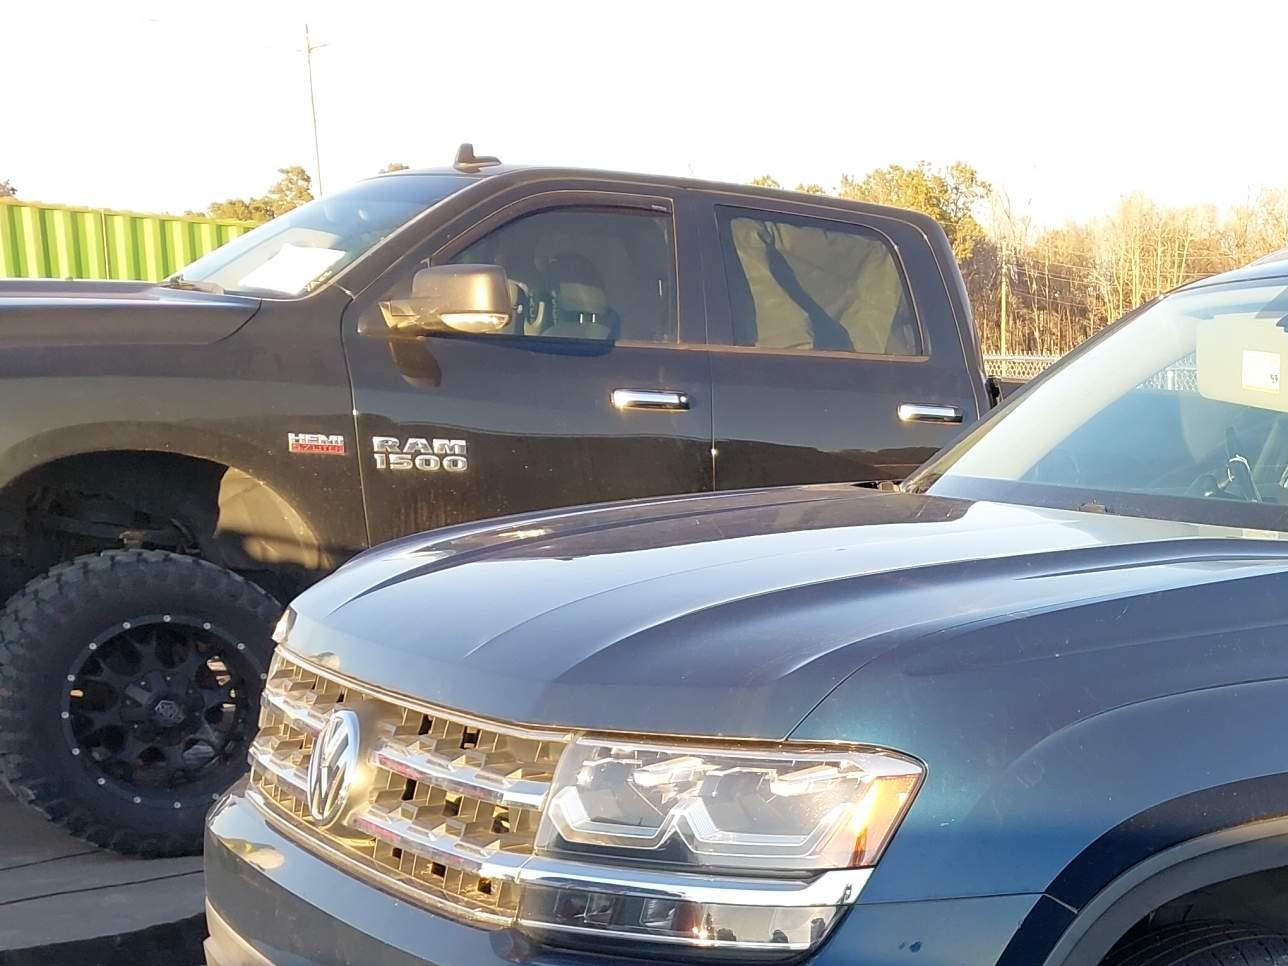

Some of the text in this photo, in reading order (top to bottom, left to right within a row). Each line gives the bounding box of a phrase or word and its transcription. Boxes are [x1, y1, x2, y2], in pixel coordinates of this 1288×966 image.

[288, 433, 344, 445] HEMI
[372, 436, 467, 455] RAM
[373, 453, 468, 472] 1500
